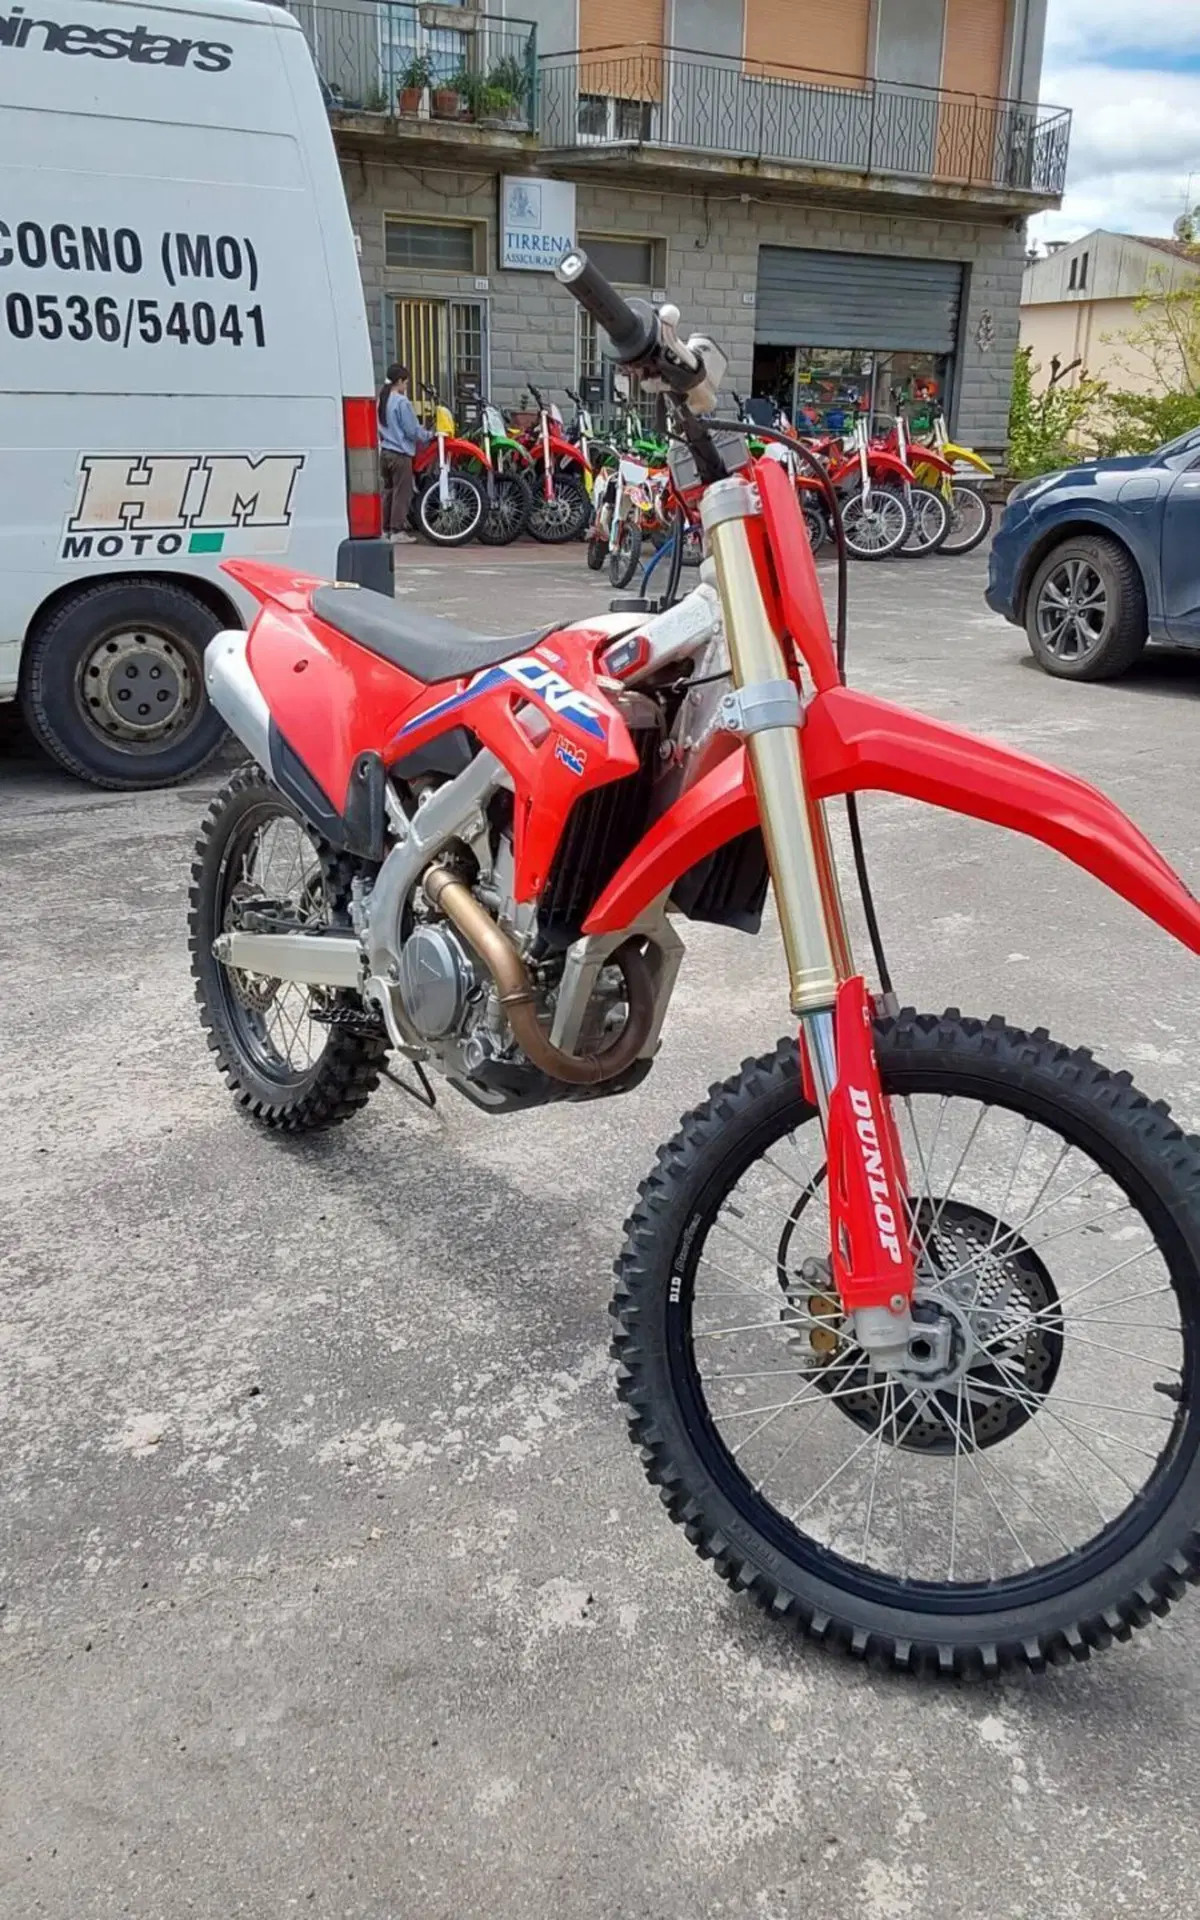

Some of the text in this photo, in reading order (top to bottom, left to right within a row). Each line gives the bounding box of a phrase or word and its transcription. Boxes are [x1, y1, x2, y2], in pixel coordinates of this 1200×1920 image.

[161, 232, 258, 291] (MO)
[505, 232, 573, 252] TIRRENA
[6, 292, 266, 348] 0536/54041
[68, 455, 305, 532] HM
[61, 533, 183, 559] MOTO
[500, 657, 607, 718] CRF
[848, 1085, 902, 1264] DUNLOP
